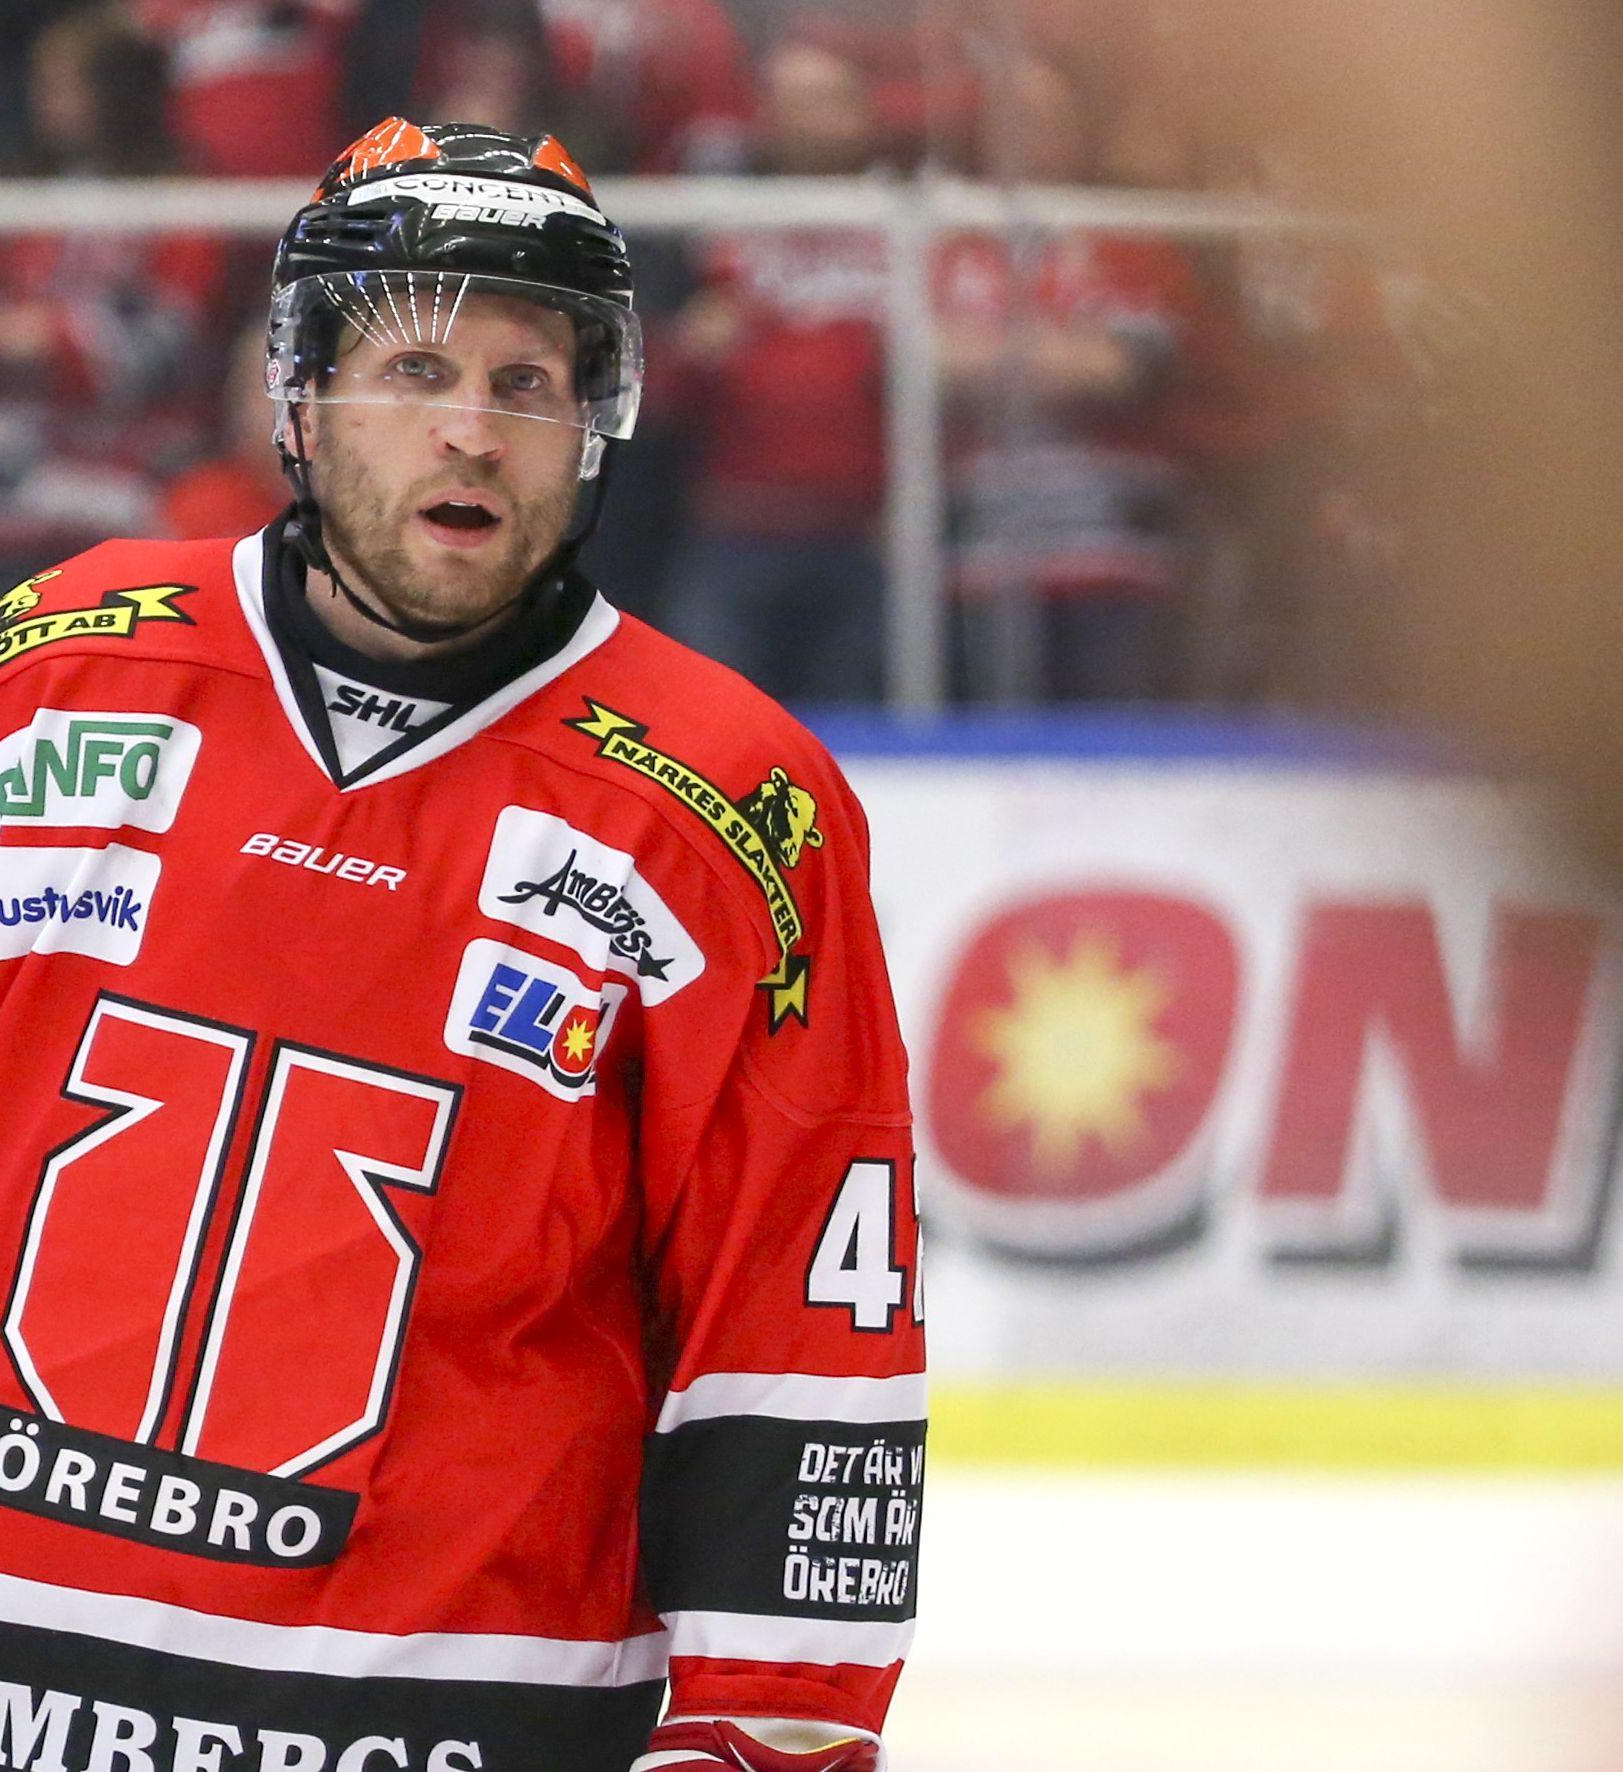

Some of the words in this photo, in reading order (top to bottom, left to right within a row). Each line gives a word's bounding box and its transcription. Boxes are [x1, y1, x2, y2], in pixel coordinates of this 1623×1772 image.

[63, 612, 117, 632] AB
[327, 684, 423, 733] SHL
[610, 740, 727, 821] NÄRKES
[240, 832, 408, 892] BAUER
[806, 1152, 925, 1332] 4
[798, 1442, 864, 1485] DET
[863, 1439, 903, 1485] ÄR
[787, 1493, 878, 1544] SOM
[783, 1545, 910, 1606] ÖREBRO
